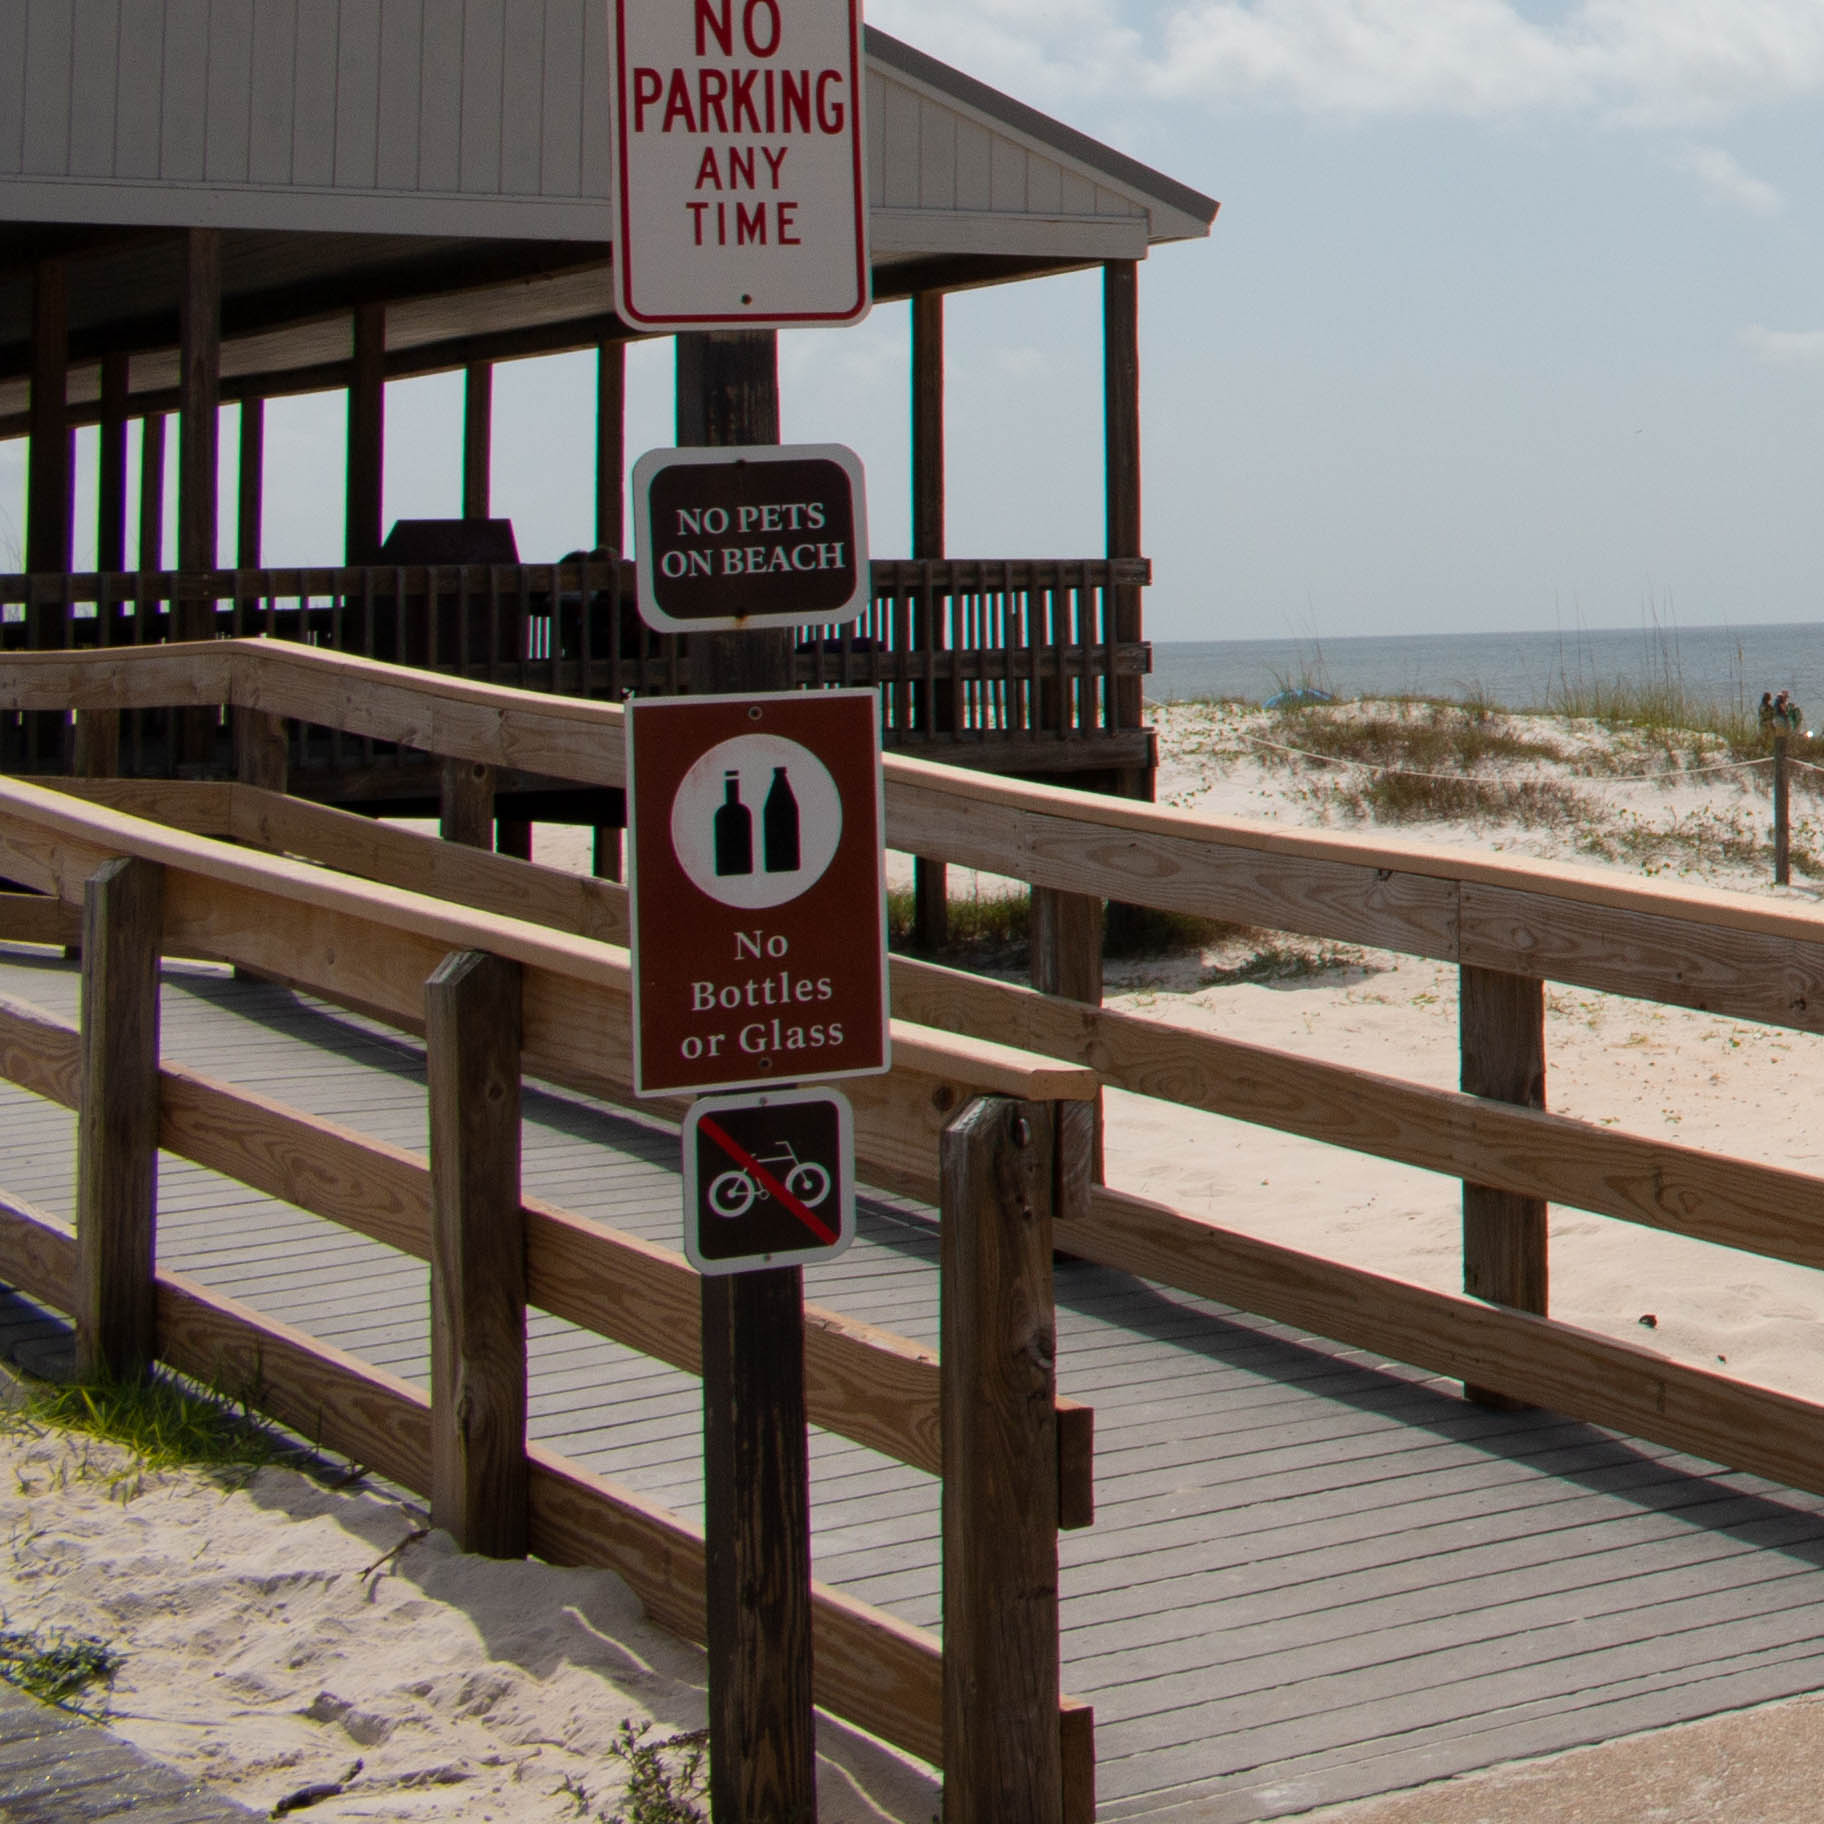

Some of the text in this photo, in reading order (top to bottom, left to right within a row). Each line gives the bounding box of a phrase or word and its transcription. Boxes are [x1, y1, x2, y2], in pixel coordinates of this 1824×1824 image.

[633, 67, 846, 135] PARKING
[694, 146, 788, 191] ANY
[686, 202, 801, 246] TIME
[675, 502, 826, 536] NO PETS
[661, 542, 846, 578] ON BEACH
[733, 930, 789, 961] No
[690, 971, 833, 1012] Bottles
[680, 1018, 845, 1060] or Glass
